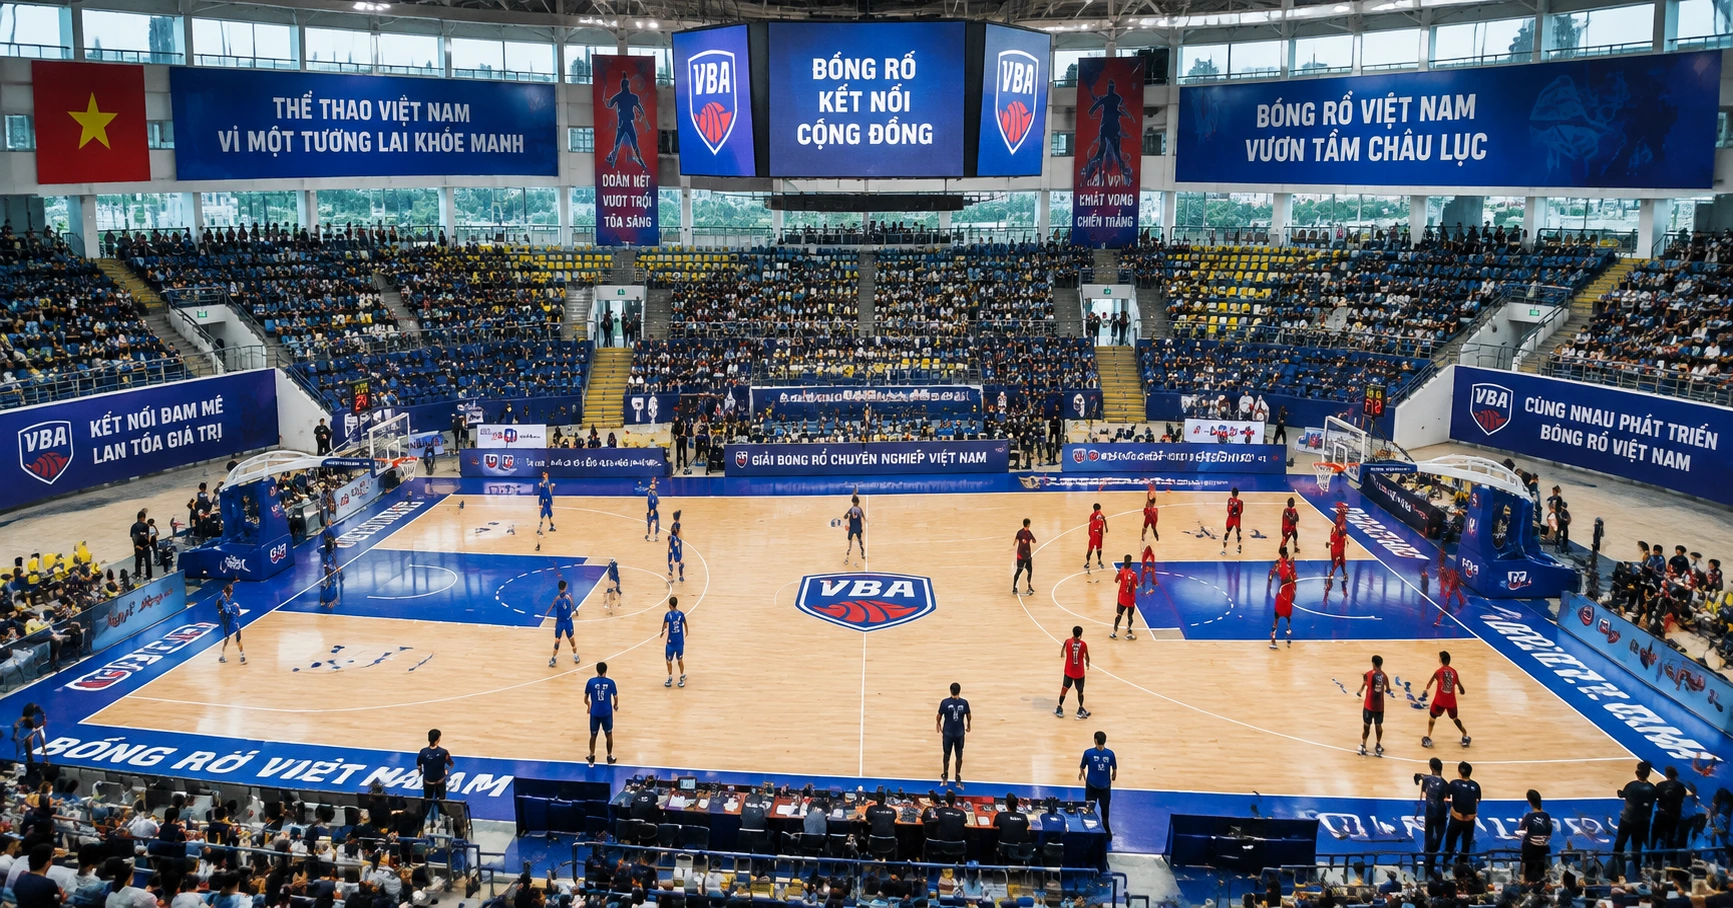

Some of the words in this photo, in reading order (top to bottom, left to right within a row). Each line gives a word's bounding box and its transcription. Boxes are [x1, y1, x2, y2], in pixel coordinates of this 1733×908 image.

[693, 61, 730, 95] VBA
[1002, 60, 1034, 95] VBA
[318, 98, 372, 122] THAO
[379, 95, 421, 127] VIỆT
[427, 102, 470, 124] NAM
[1256, 97, 1316, 128] BÓNG
[1419, 94, 1476, 121] NAM
[378, 131, 408, 152] LAI
[471, 133, 524, 153] MANH
[1245, 136, 1305, 162] VƯƠN
[1368, 128, 1432, 162] CHÂU
[1440, 132, 1488, 167] LỤC
[1475, 387, 1508, 409] VBA
[24, 426, 67, 453] VBA
[90, 410, 122, 439] KẾT
[93, 441, 126, 465] LAN
[168, 429, 194, 450] GIÁ
[198, 423, 222, 443] TRỊ
[959, 451, 987, 465] NAM
[1613, 438, 1648, 463] VIỆT
[1651, 447, 1691, 472] NAM
[819, 579, 915, 598] VBA
